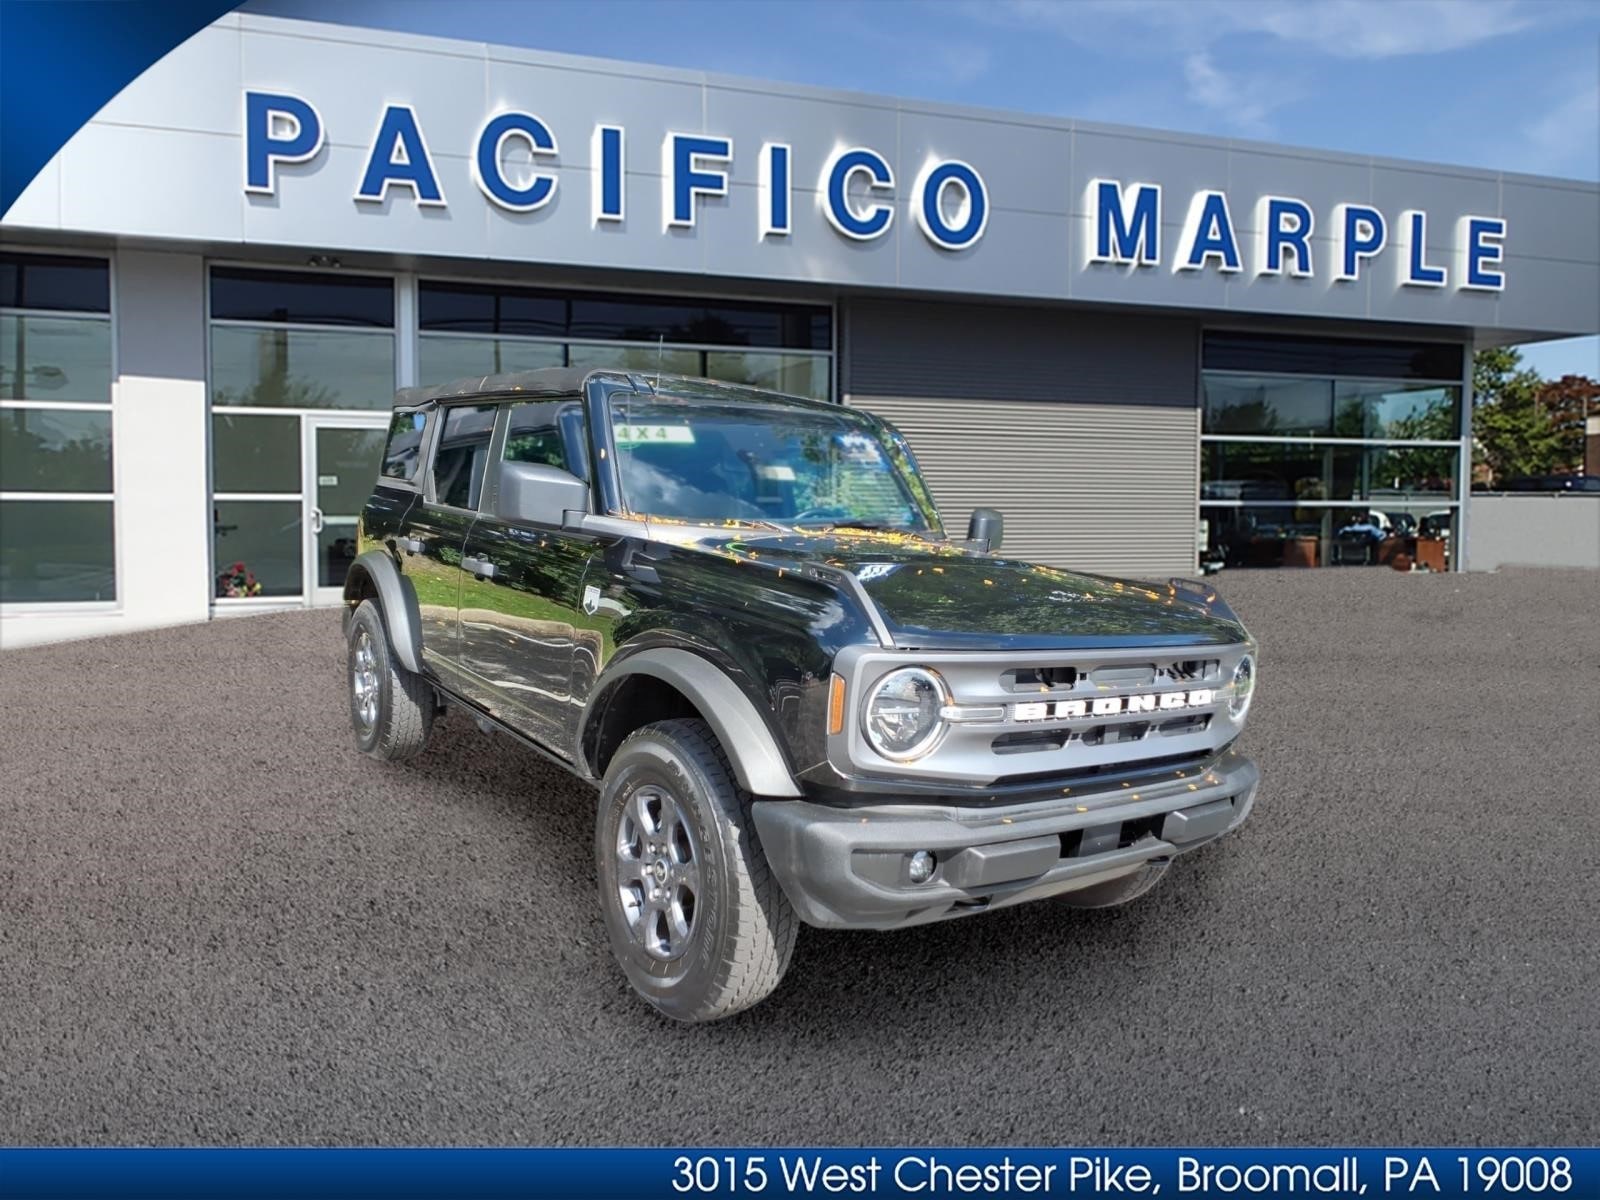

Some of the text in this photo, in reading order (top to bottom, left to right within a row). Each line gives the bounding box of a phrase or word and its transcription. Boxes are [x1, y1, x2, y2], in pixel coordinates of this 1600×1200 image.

[244, 88, 1507, 291] PACIFICO MARPLE
[1014, 689, 1215, 721] BRONCO
